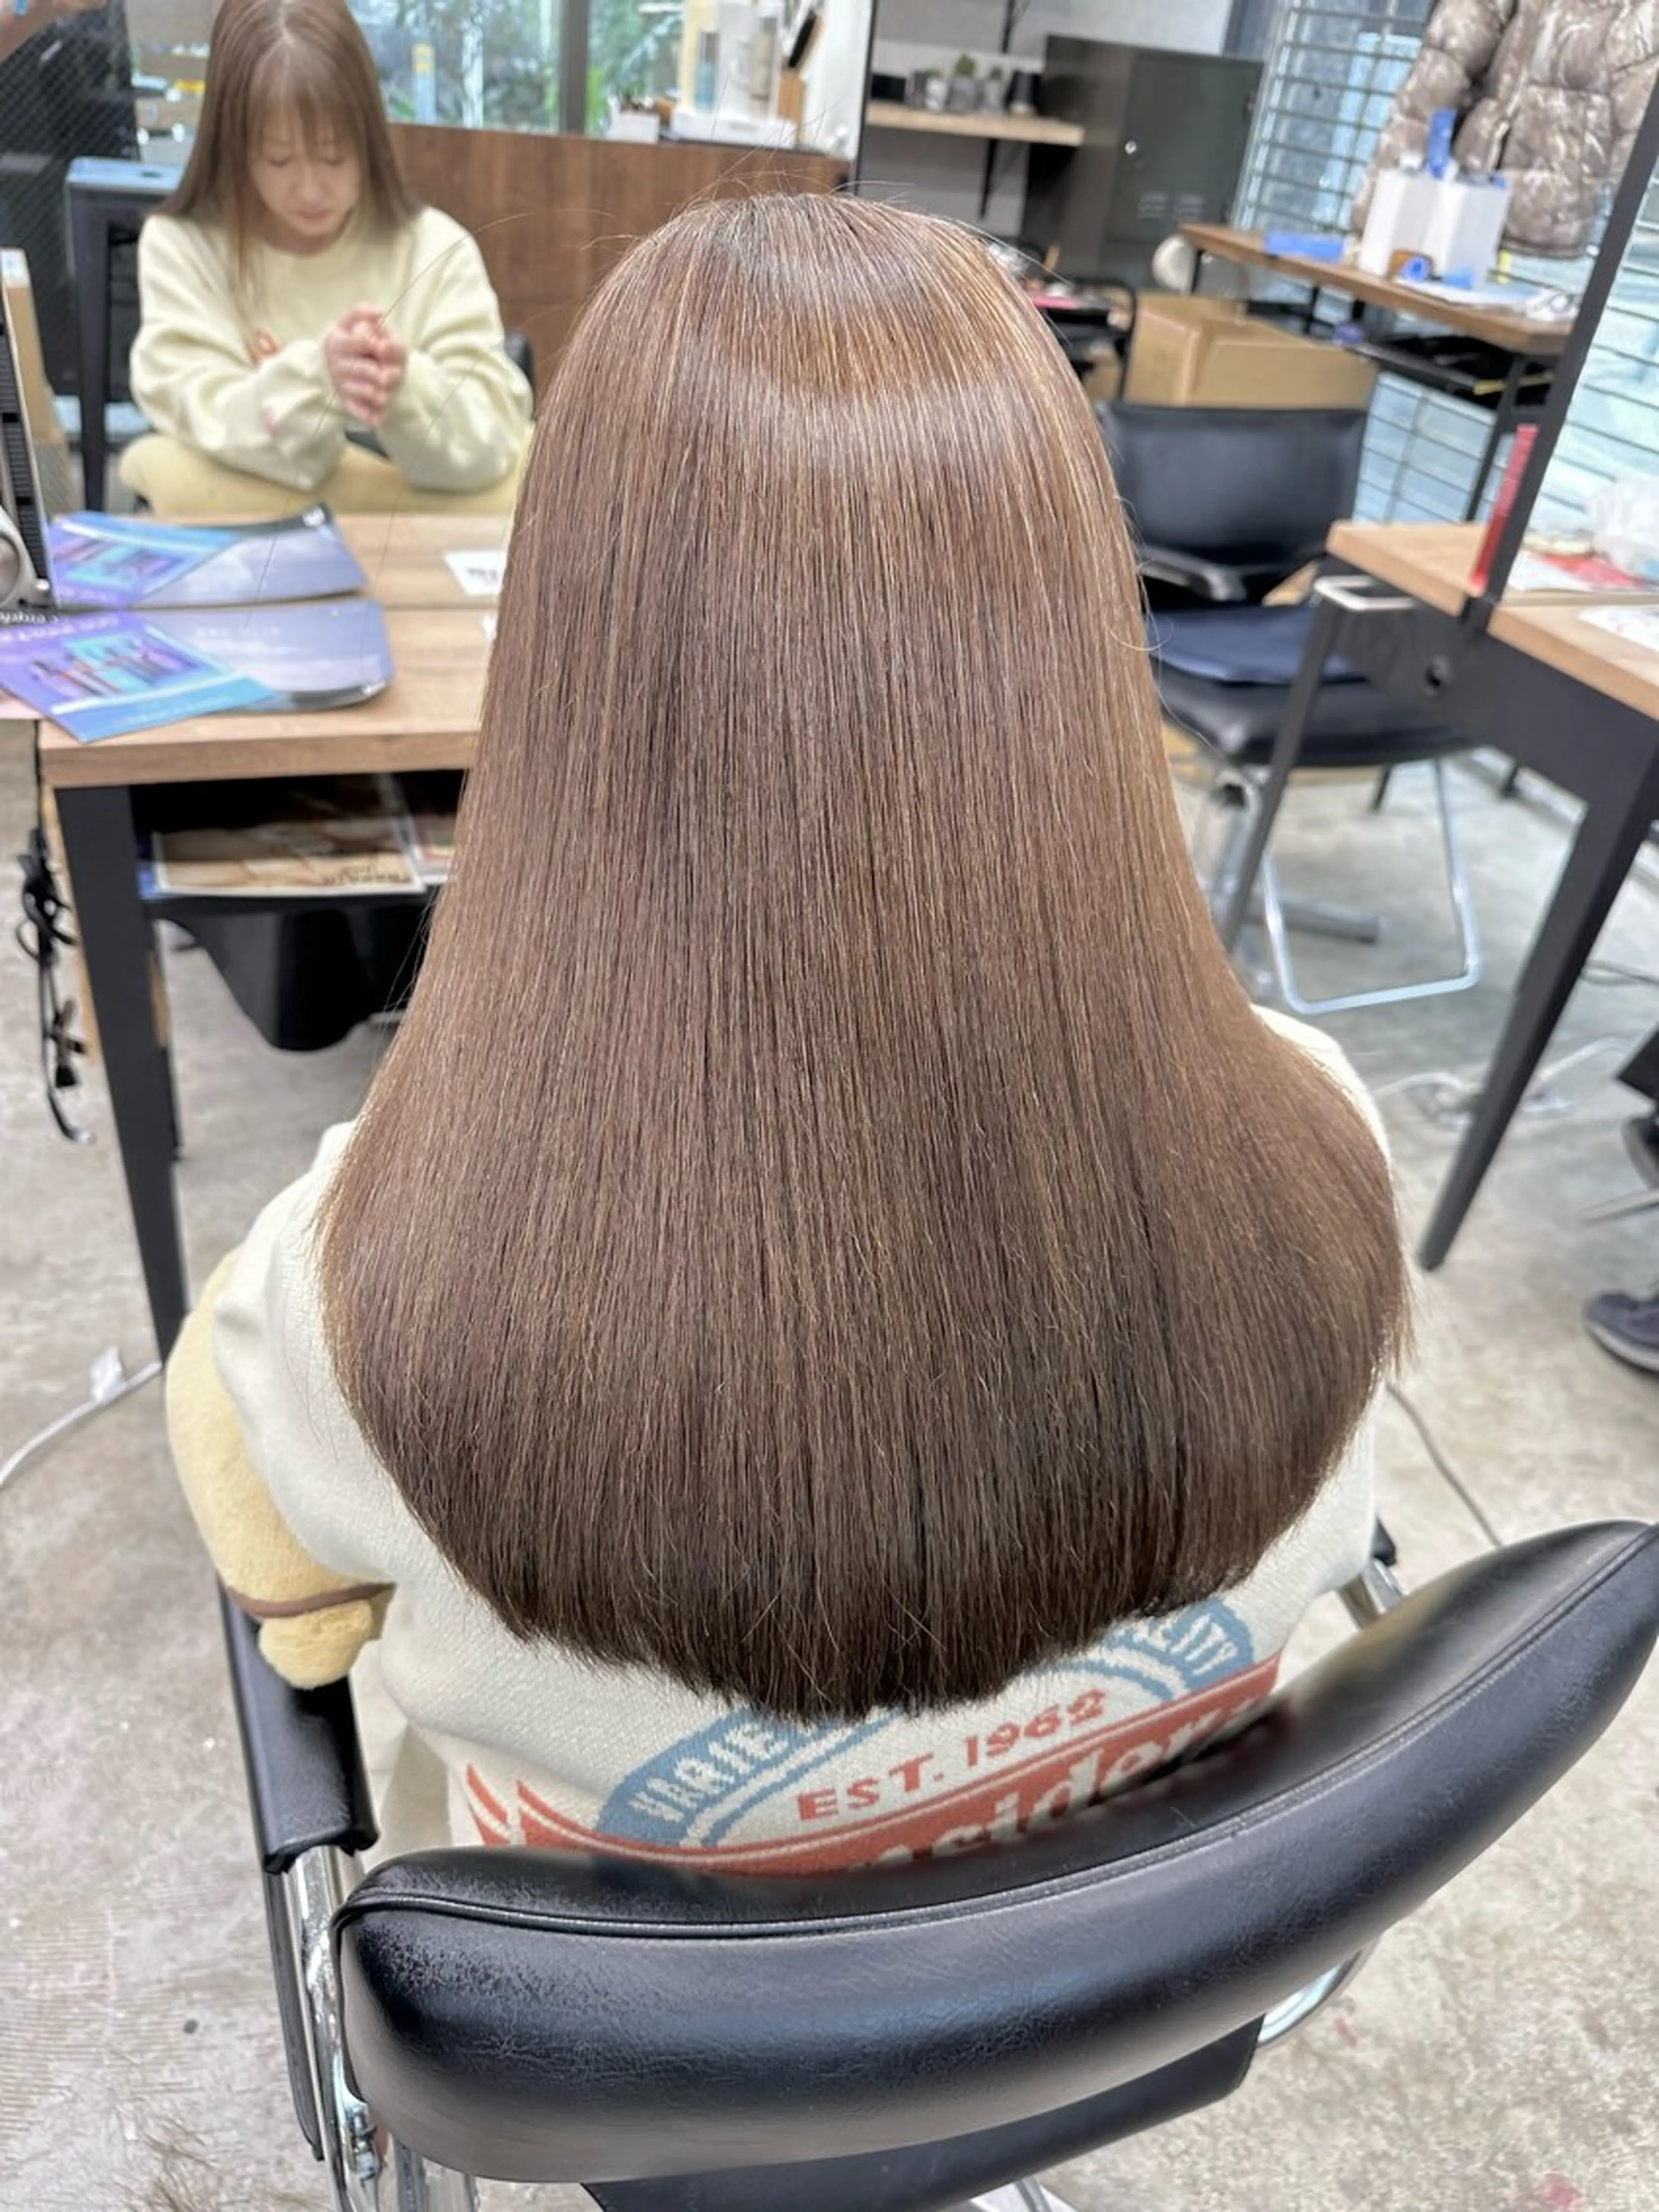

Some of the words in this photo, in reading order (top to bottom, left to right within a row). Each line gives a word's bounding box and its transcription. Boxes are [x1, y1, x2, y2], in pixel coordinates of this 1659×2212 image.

[628, 1722, 811, 1822] VARIE
[796, 1751, 944, 1821] EST.
[963, 1688, 1107, 1768] 1962
